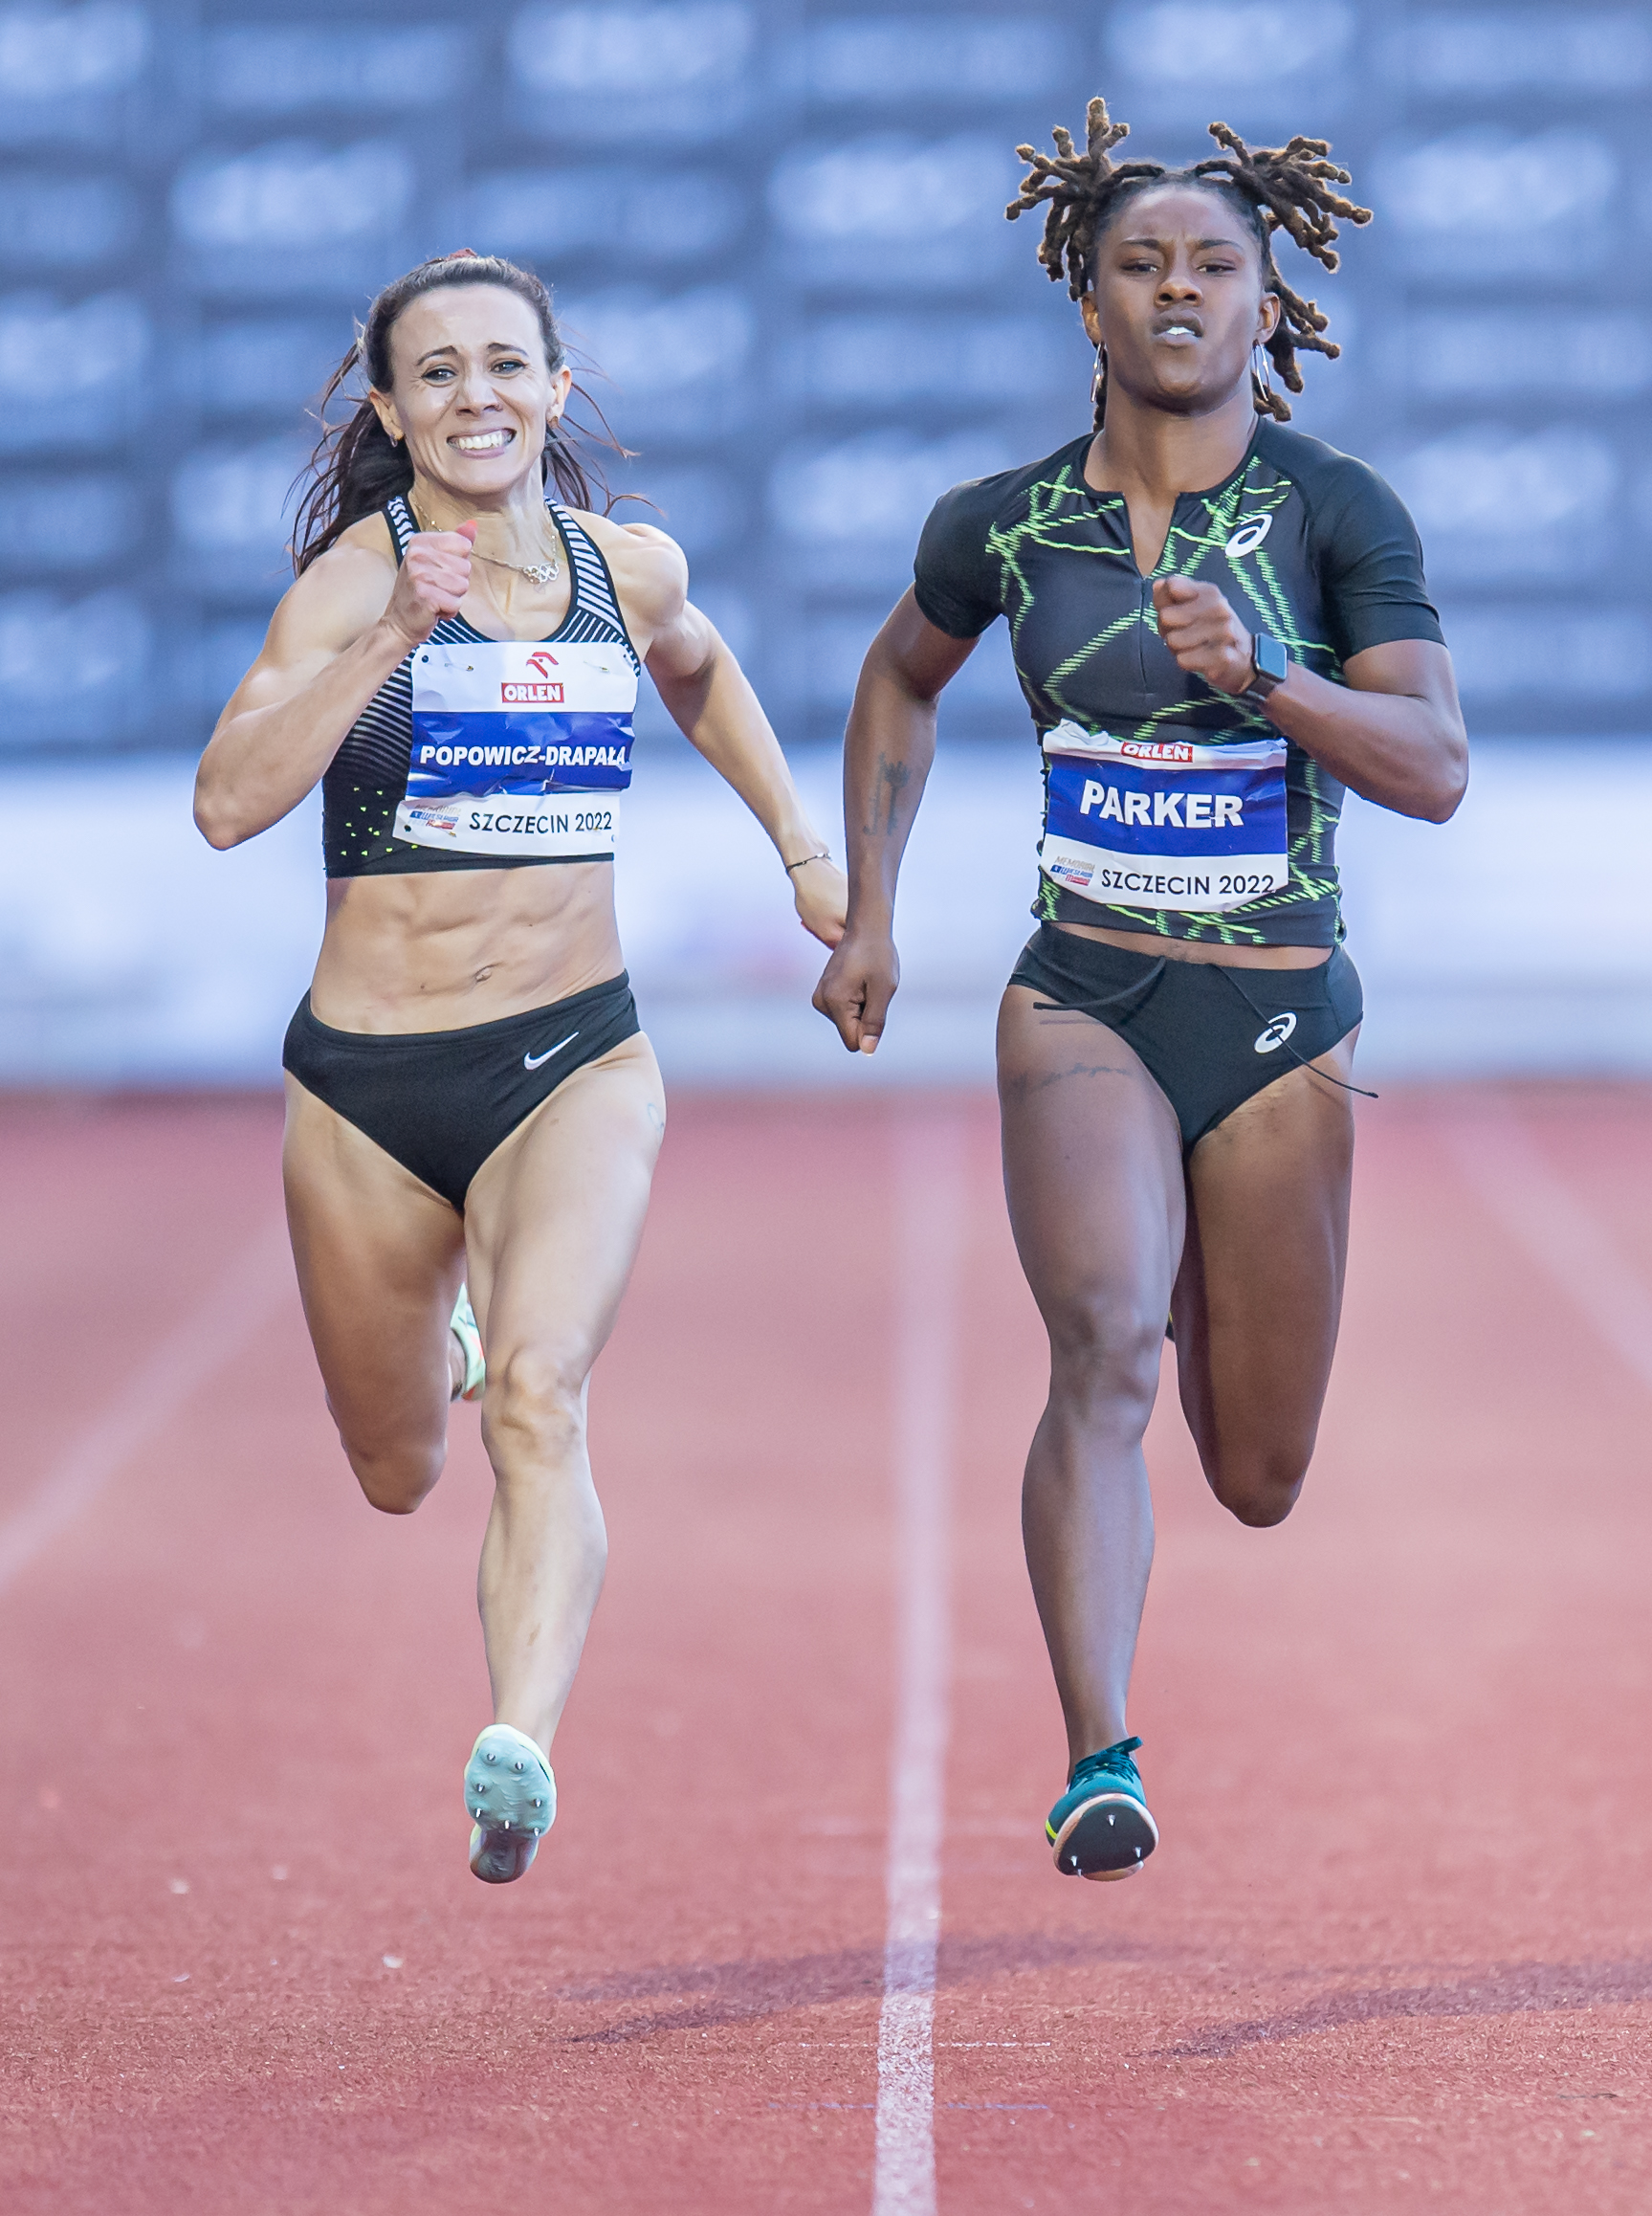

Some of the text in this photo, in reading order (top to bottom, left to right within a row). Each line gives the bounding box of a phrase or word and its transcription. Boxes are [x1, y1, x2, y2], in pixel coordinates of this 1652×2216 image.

[504, 684, 562, 701] ORLEN
[420, 744, 626, 766] POPOWICZ-DRAPAŁA
[1123, 742, 1191, 762] ORLEN
[1079, 779, 1244, 829] PARKER
[469, 811, 569, 834] SZCZECIN
[575, 811, 612, 832] 2022
[1101, 869, 1210, 896] SZCZECIN
[1219, 875, 1274, 894] 2022
